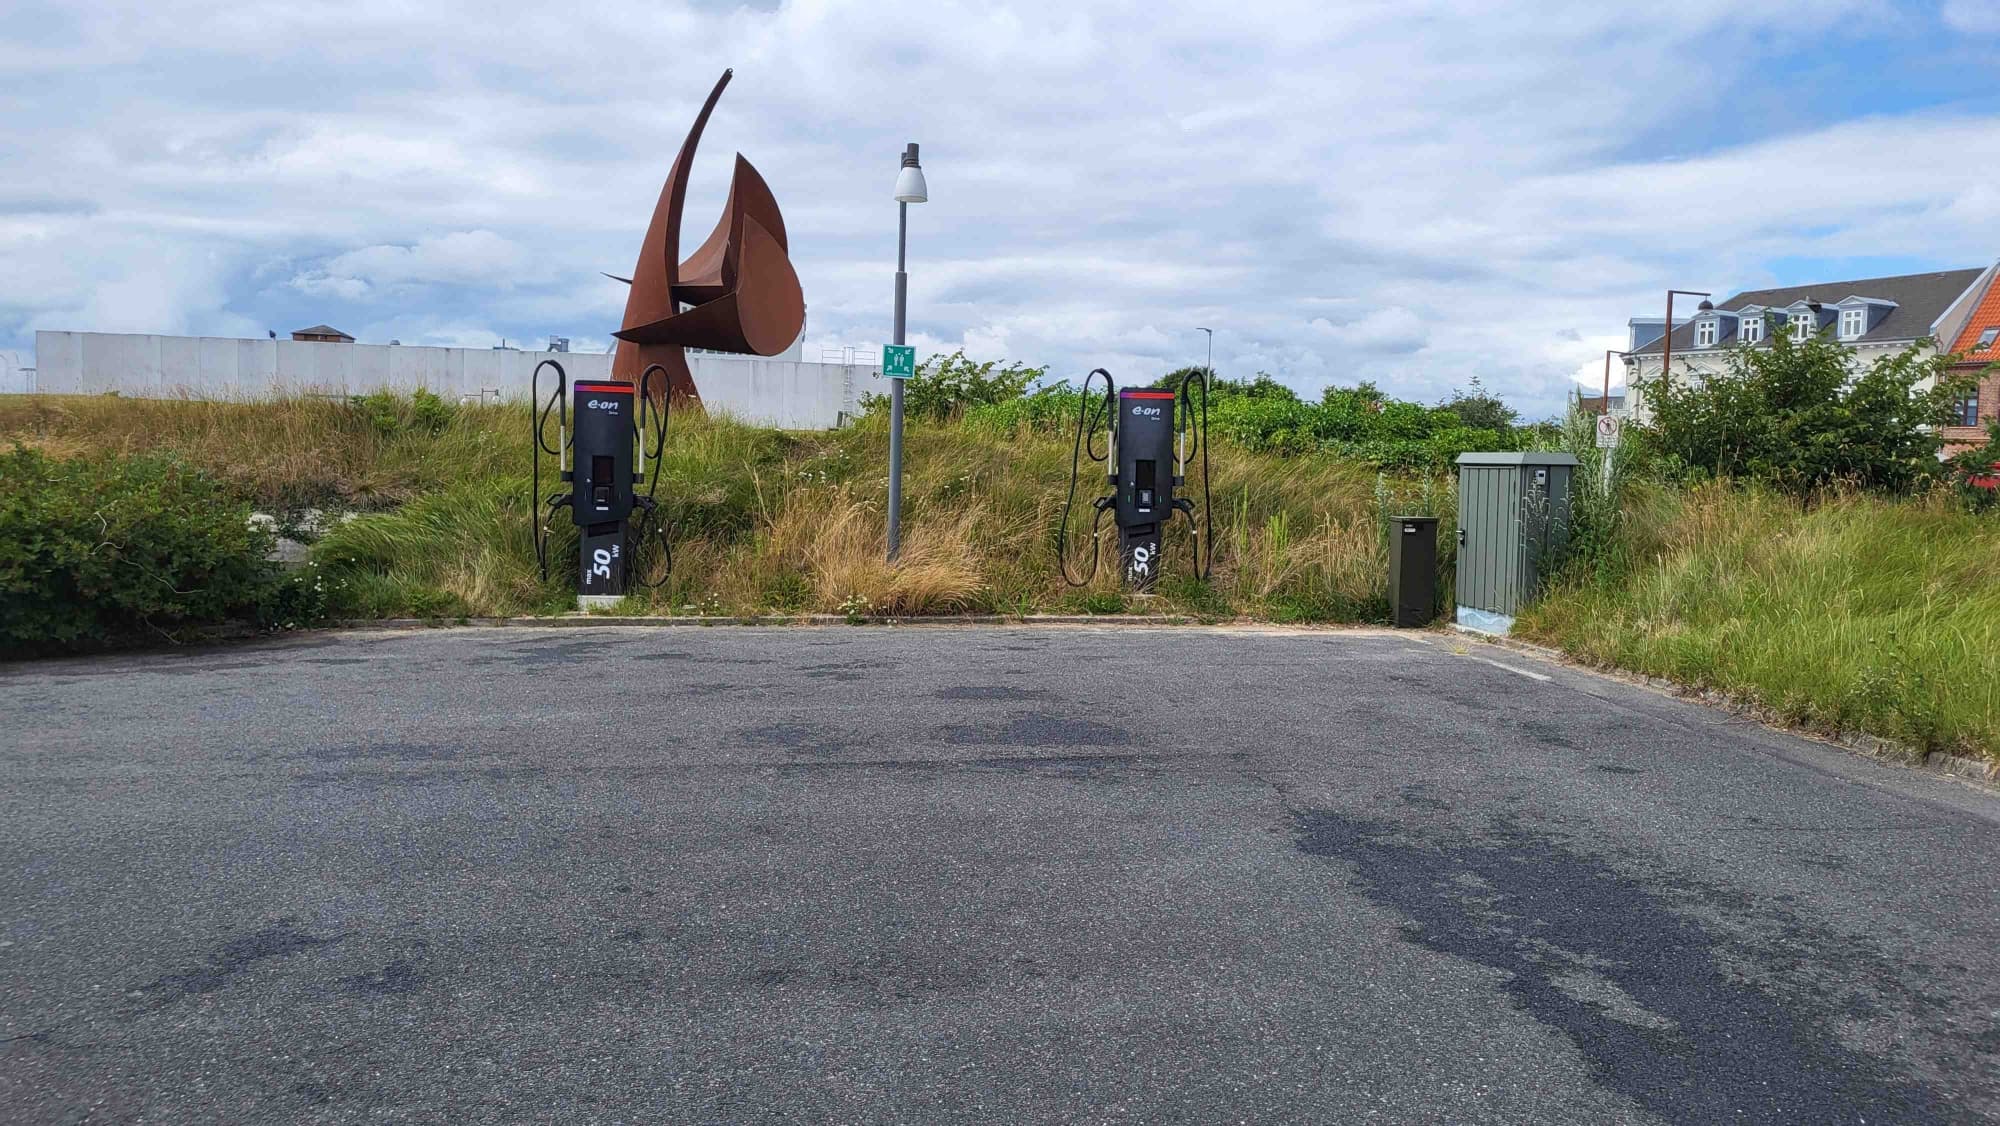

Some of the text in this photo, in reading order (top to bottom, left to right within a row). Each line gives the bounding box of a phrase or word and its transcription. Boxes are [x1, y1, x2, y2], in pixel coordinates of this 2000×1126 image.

[611, 544, 620, 558] kW
[1150, 542, 1156, 555] kW
[593, 548, 611, 580] 50
[1134, 546, 1149, 576] 50
